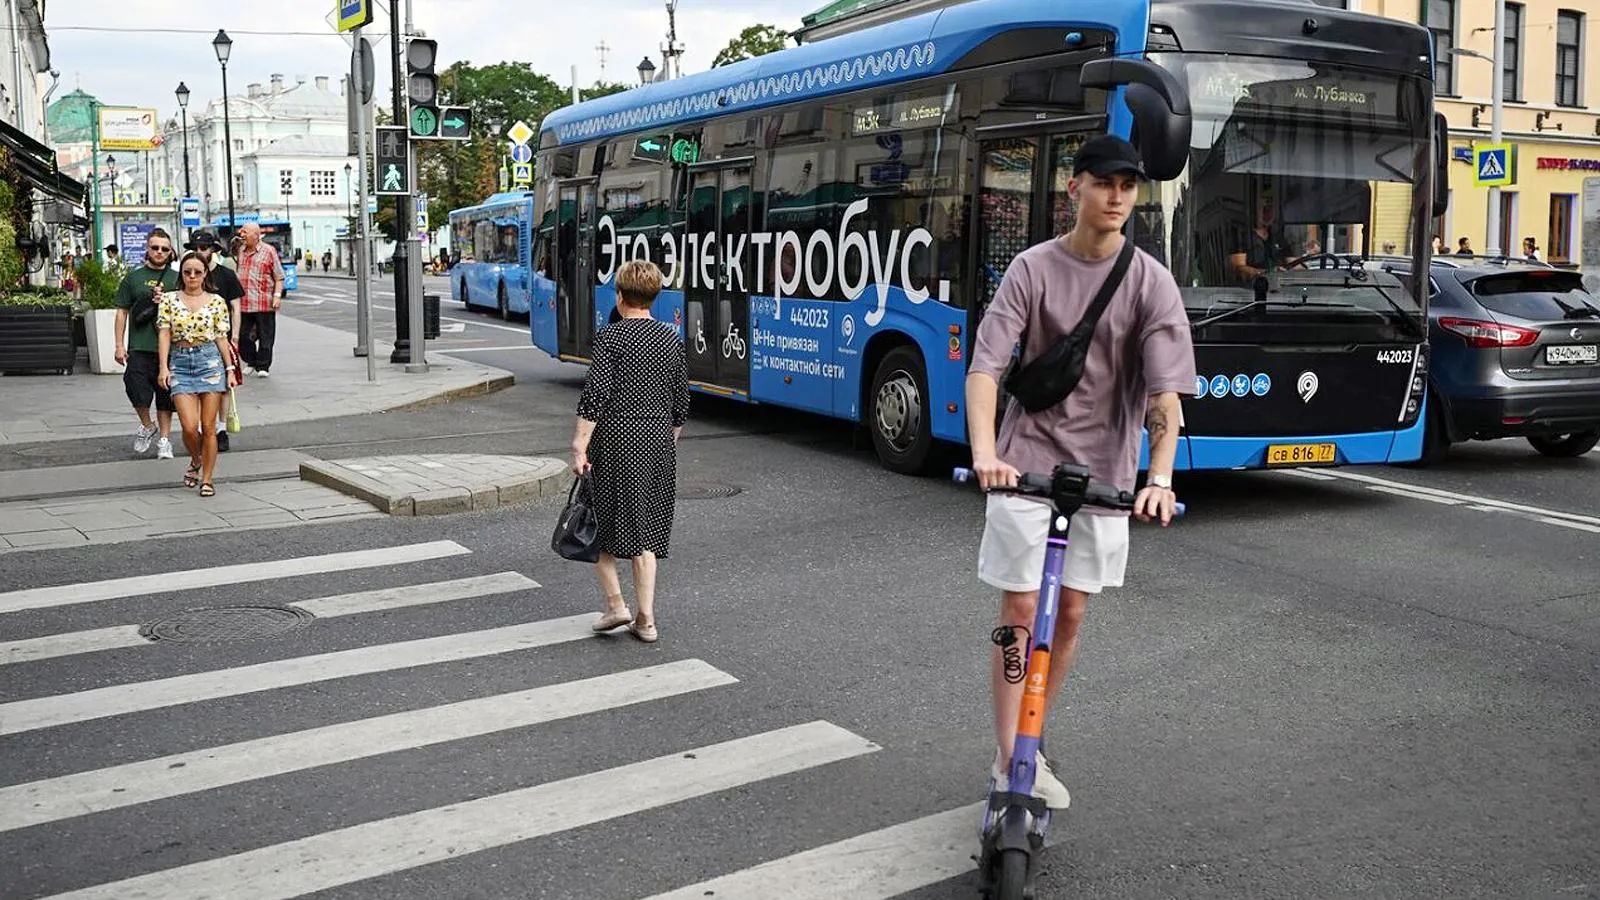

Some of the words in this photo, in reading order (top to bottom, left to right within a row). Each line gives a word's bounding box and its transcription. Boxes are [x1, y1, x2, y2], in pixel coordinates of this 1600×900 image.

[1313, 85, 1366, 104] Лубянка
[597, 215, 651, 284] Это
[790, 307, 829, 328] 442023
[763, 330, 775, 348] Не
[776, 337, 819, 353] привязан
[762, 355, 769, 368] к
[769, 356, 821, 376] контактной
[822, 362, 845, 379] сети
[1376, 350, 1413, 364] 442023
[1273, 450, 1288, 461] СВ
[1292, 446, 1314, 460] 816
[1320, 444, 1332, 456] 77
